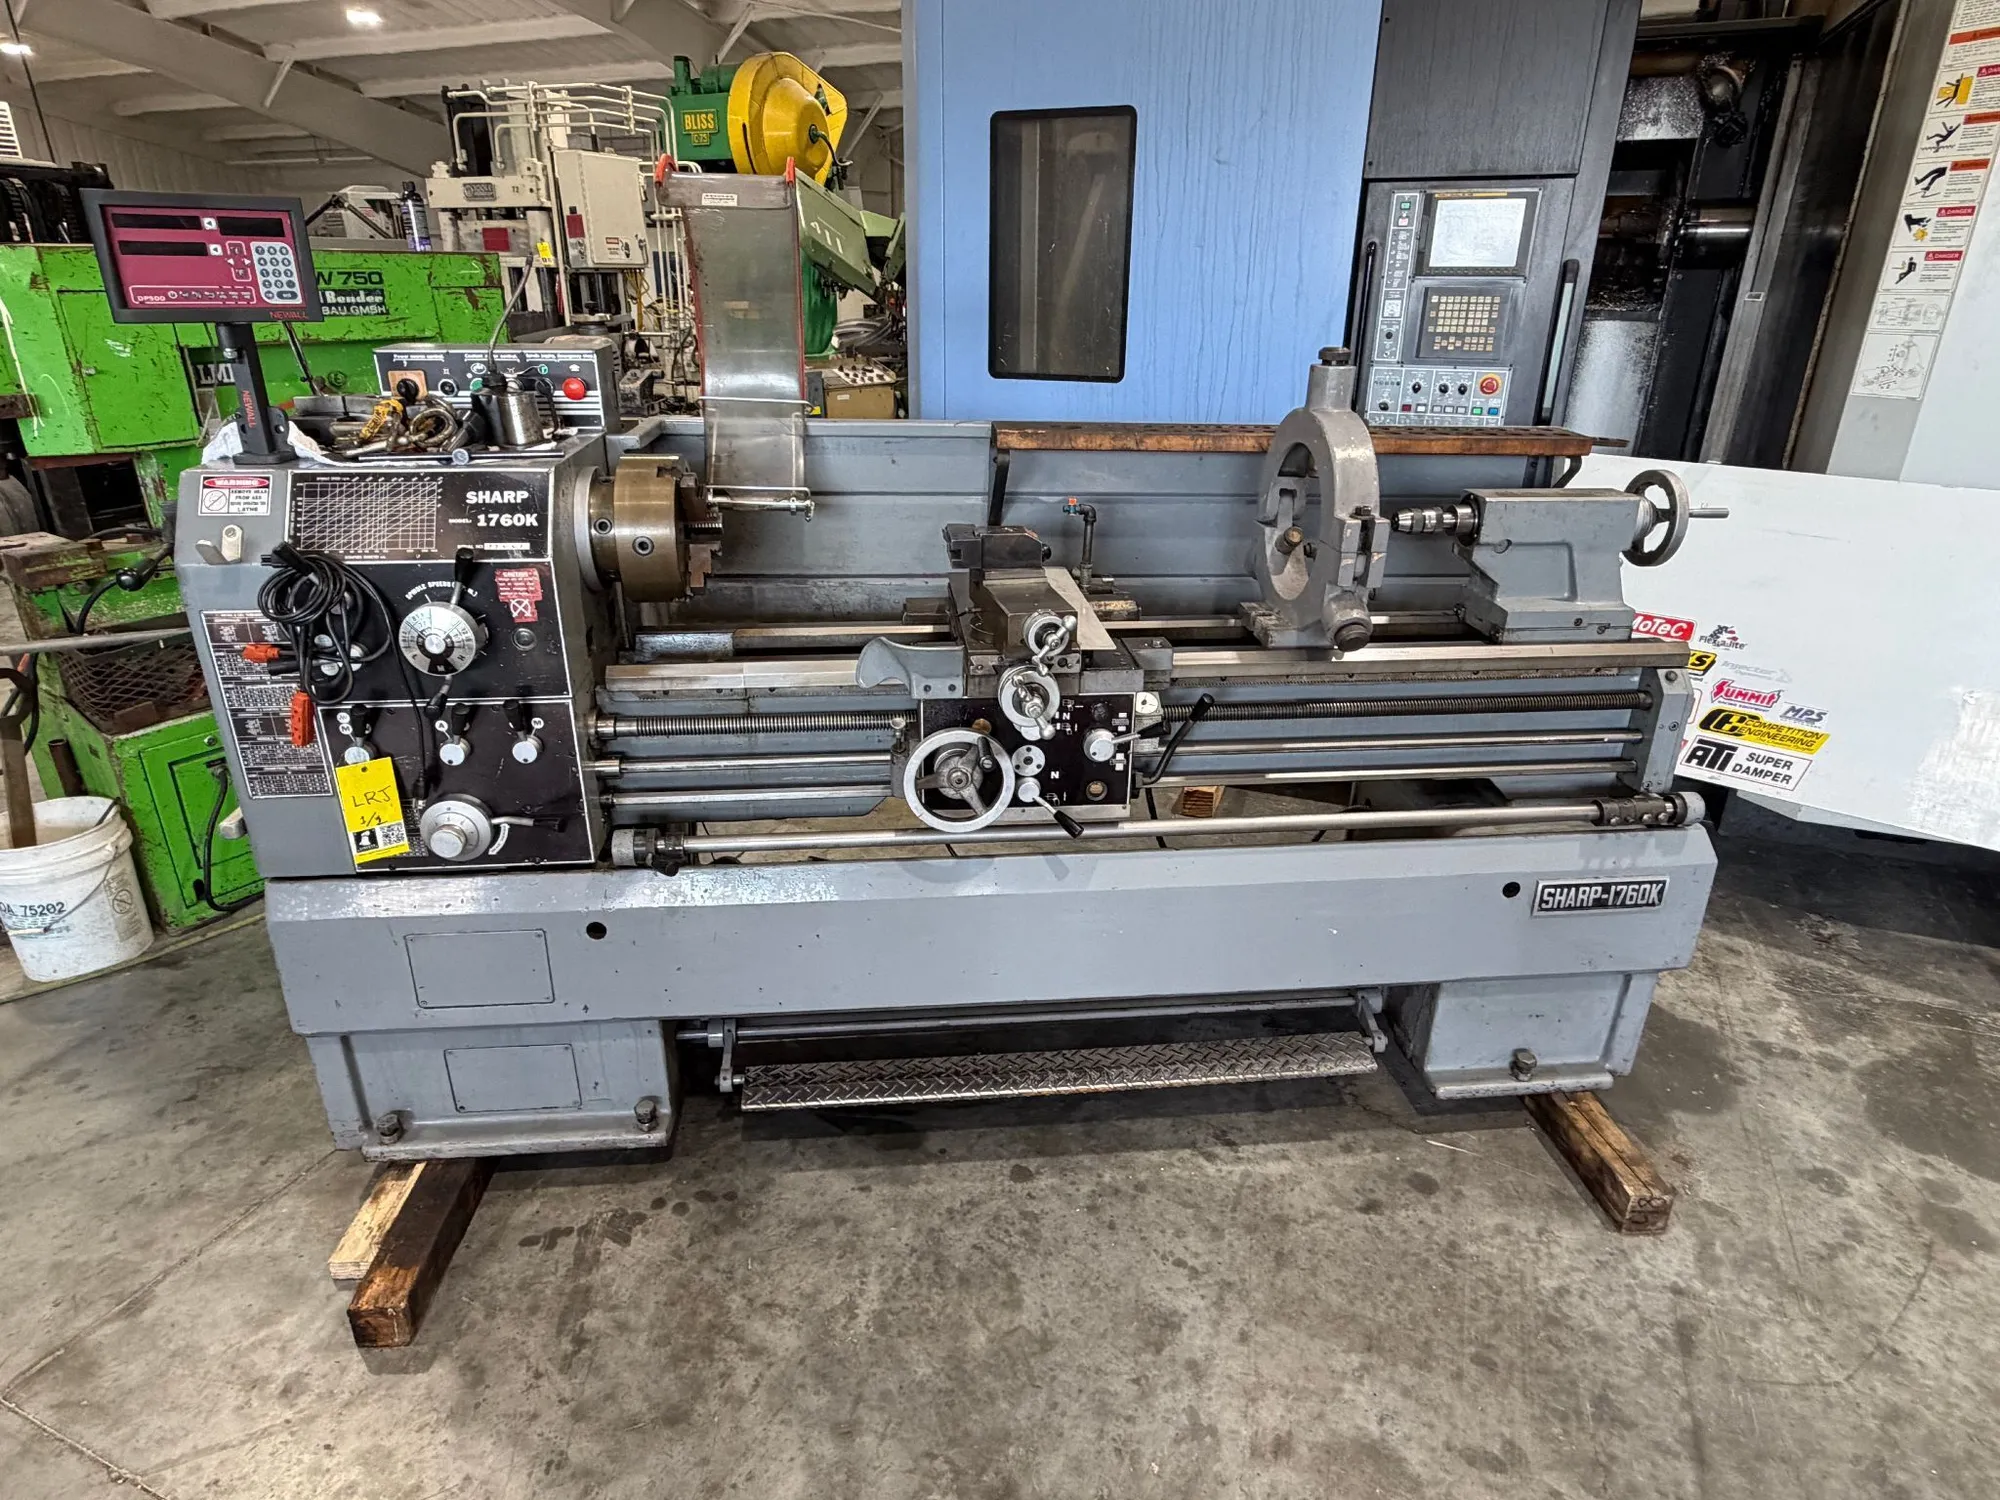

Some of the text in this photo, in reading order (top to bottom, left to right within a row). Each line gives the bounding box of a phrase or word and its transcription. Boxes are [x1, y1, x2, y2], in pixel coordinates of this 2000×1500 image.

[684, 113, 715, 130] BLISS
[337, 271, 384, 285] 750
[325, 290, 383, 304] Bender
[270, 311, 309, 319] NEWALL
[322, 306, 346, 315] BAU
[242, 390, 257, 428] NEWALL
[466, 490, 529, 504] SHARP
[477, 513, 538, 527] 1760K
[1632, 615, 1687, 637] MoTeC
[1062, 712, 1070, 720] N
[1784, 705, 1828, 723] MPS
[1737, 726, 1817, 747] ENGINEERING
[1744, 719, 1824, 740] COMPETITION
[1746, 752, 1793, 771] SUPER
[1050, 771, 1059, 779] N
[1731, 763, 1793, 785] DAMPER
[351, 785, 391, 807] LRJ
[1541, 883, 1663, 909] SHARP-1760K
[20, 901, 67, 916] 75202
